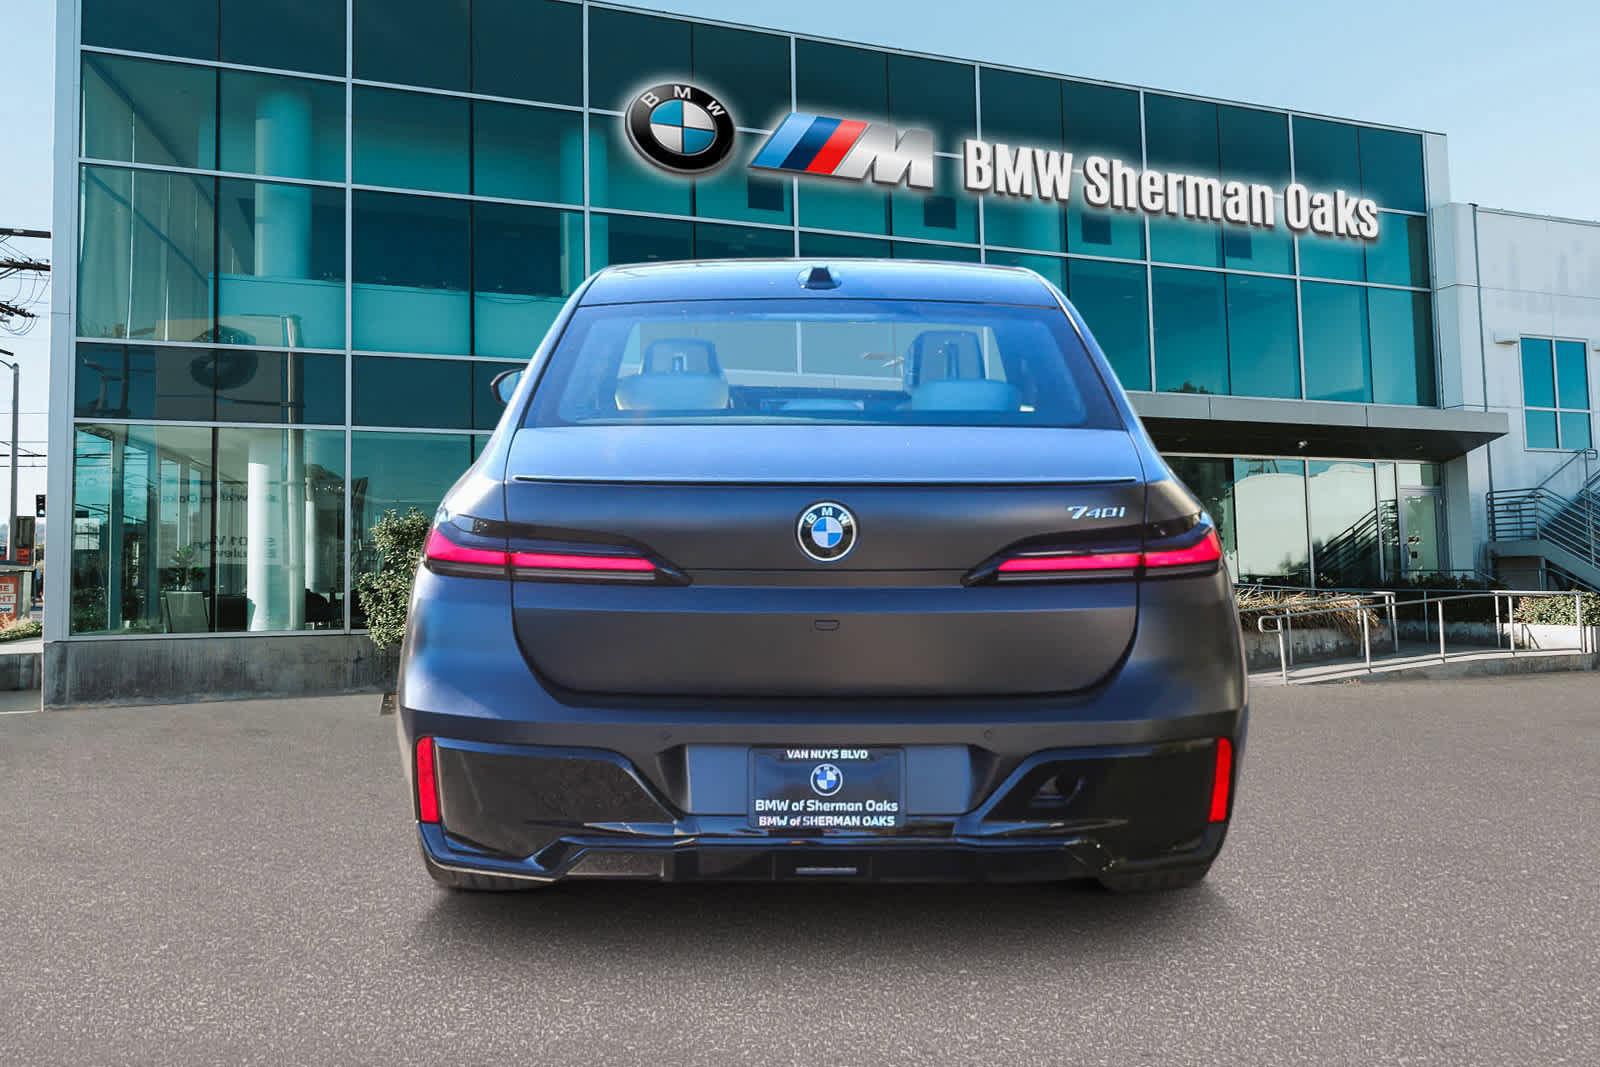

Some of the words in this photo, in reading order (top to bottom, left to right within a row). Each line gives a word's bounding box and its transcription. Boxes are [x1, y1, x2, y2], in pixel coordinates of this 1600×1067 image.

[641, 85, 725, 117] BMW
[963, 138, 1073, 203] BMW
[1082, 155, 1275, 229] Sherman
[1283, 182, 1380, 243] Oaks
[806, 507, 852, 526] BMW
[786, 749, 808, 759] VAN
[810, 749, 839, 759] NUYS
[841, 749, 868, 759] BLVD
[755, 799, 789, 811] BMW
[791, 799, 805, 811] of
[806, 799, 863, 811] Sherman
[865, 799, 898, 811] Oaks
[758, 815, 787, 826] BMW
[789, 815, 801, 826] of
[802, 815, 860, 826] SHERMAN
[862, 815, 895, 826] OAKS
